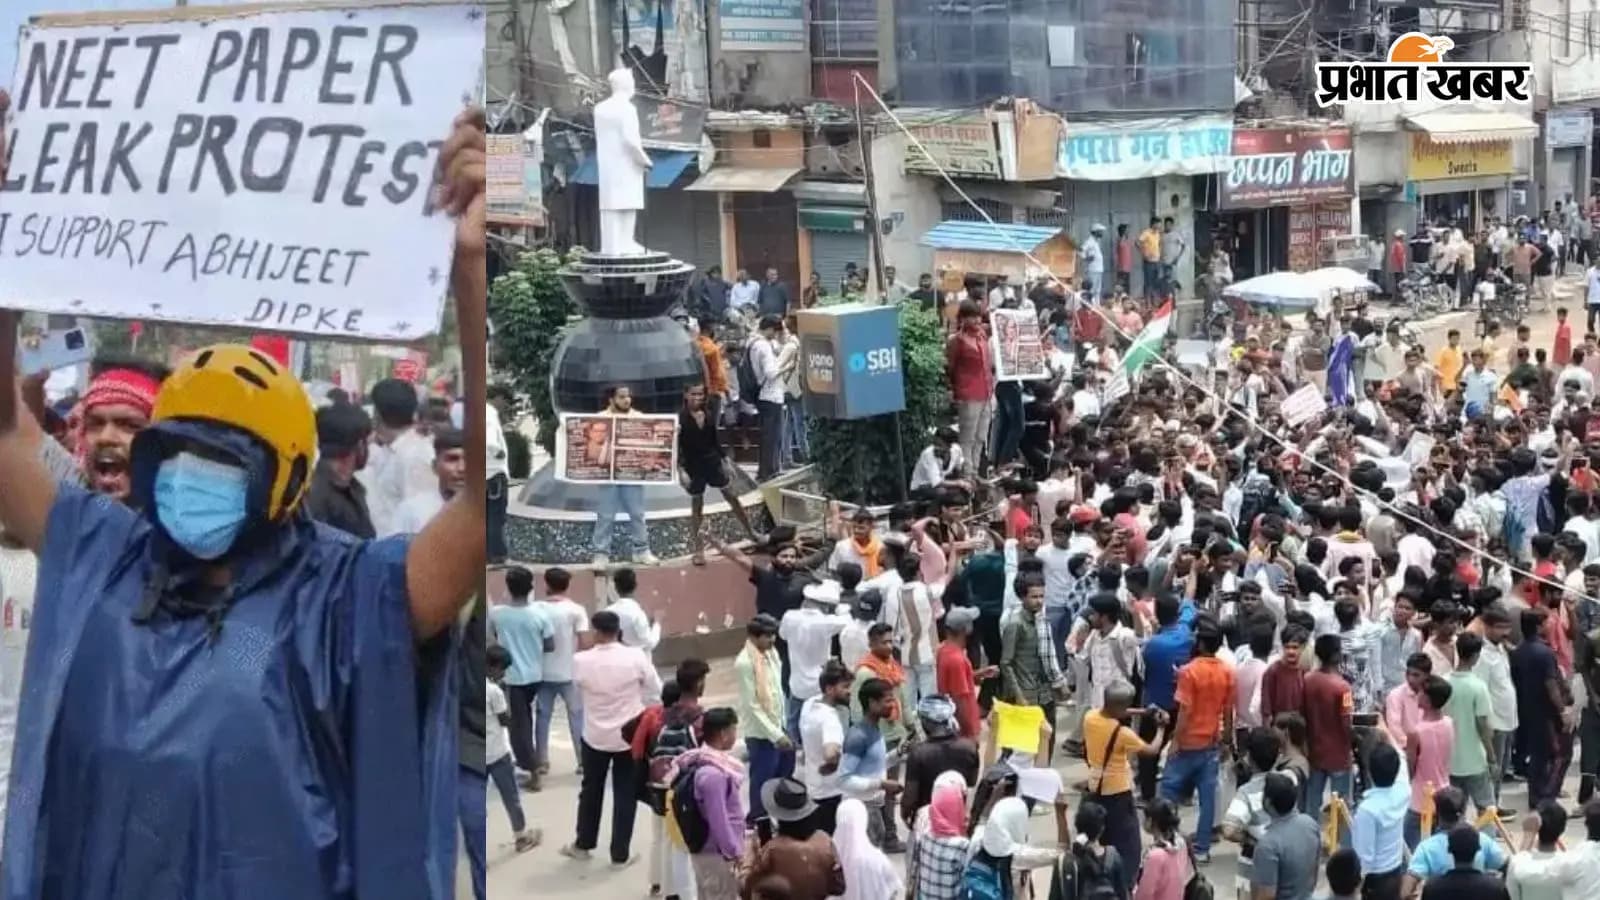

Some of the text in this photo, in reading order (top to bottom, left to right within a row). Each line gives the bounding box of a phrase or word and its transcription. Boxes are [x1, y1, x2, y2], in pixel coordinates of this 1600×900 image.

[18, 25, 418, 112] NEET PAPER
[0, 121, 153, 195] LEAK
[157, 113, 446, 217] PROTEST
[1227, 139, 1352, 188] छप्पन भोग
[1448, 160, 1478, 175] Sweets
[15, 212, 168, 269] SUPPORT
[163, 233, 370, 286] ABHIJEET
[244, 298, 363, 332] DIPKE
[809, 353, 834, 368] yono
[867, 347, 897, 370] SBI
